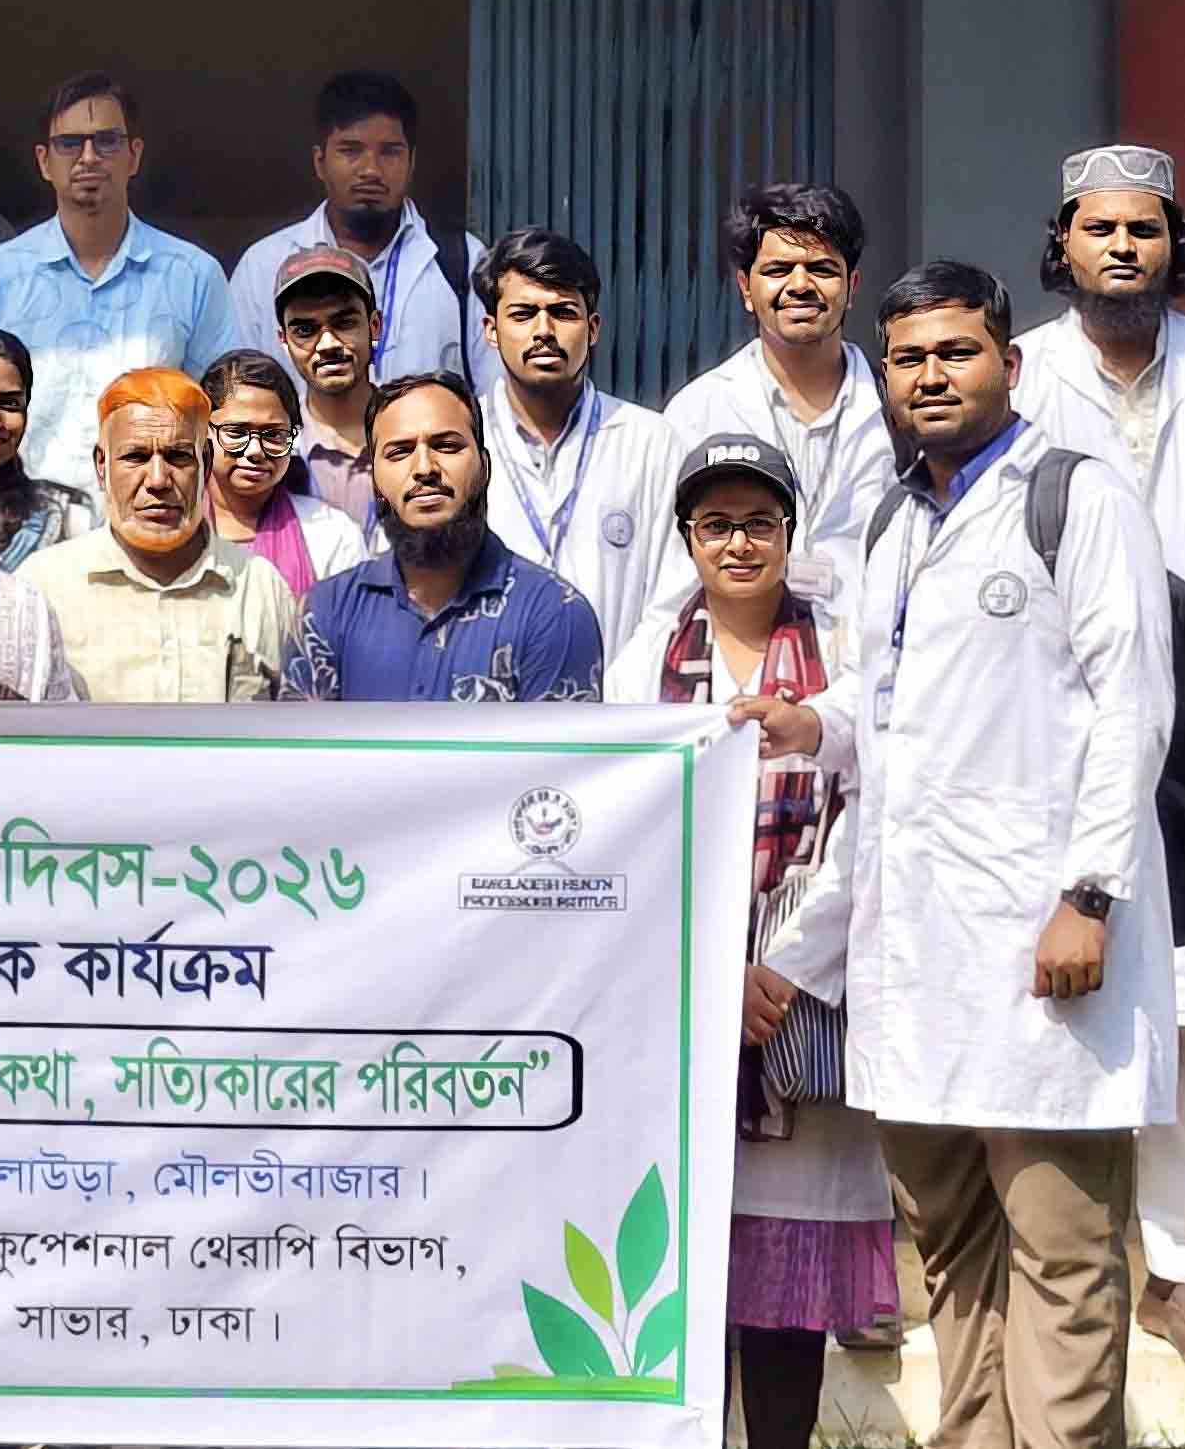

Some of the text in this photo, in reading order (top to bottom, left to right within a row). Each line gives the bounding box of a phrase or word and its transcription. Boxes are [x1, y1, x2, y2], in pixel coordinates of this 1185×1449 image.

[58, 921, 275, 1001] কার্যক্রম
[112, 1036, 342, 1113] সত্যিকারের
[189, 1223, 319, 1271] থেরাপি
